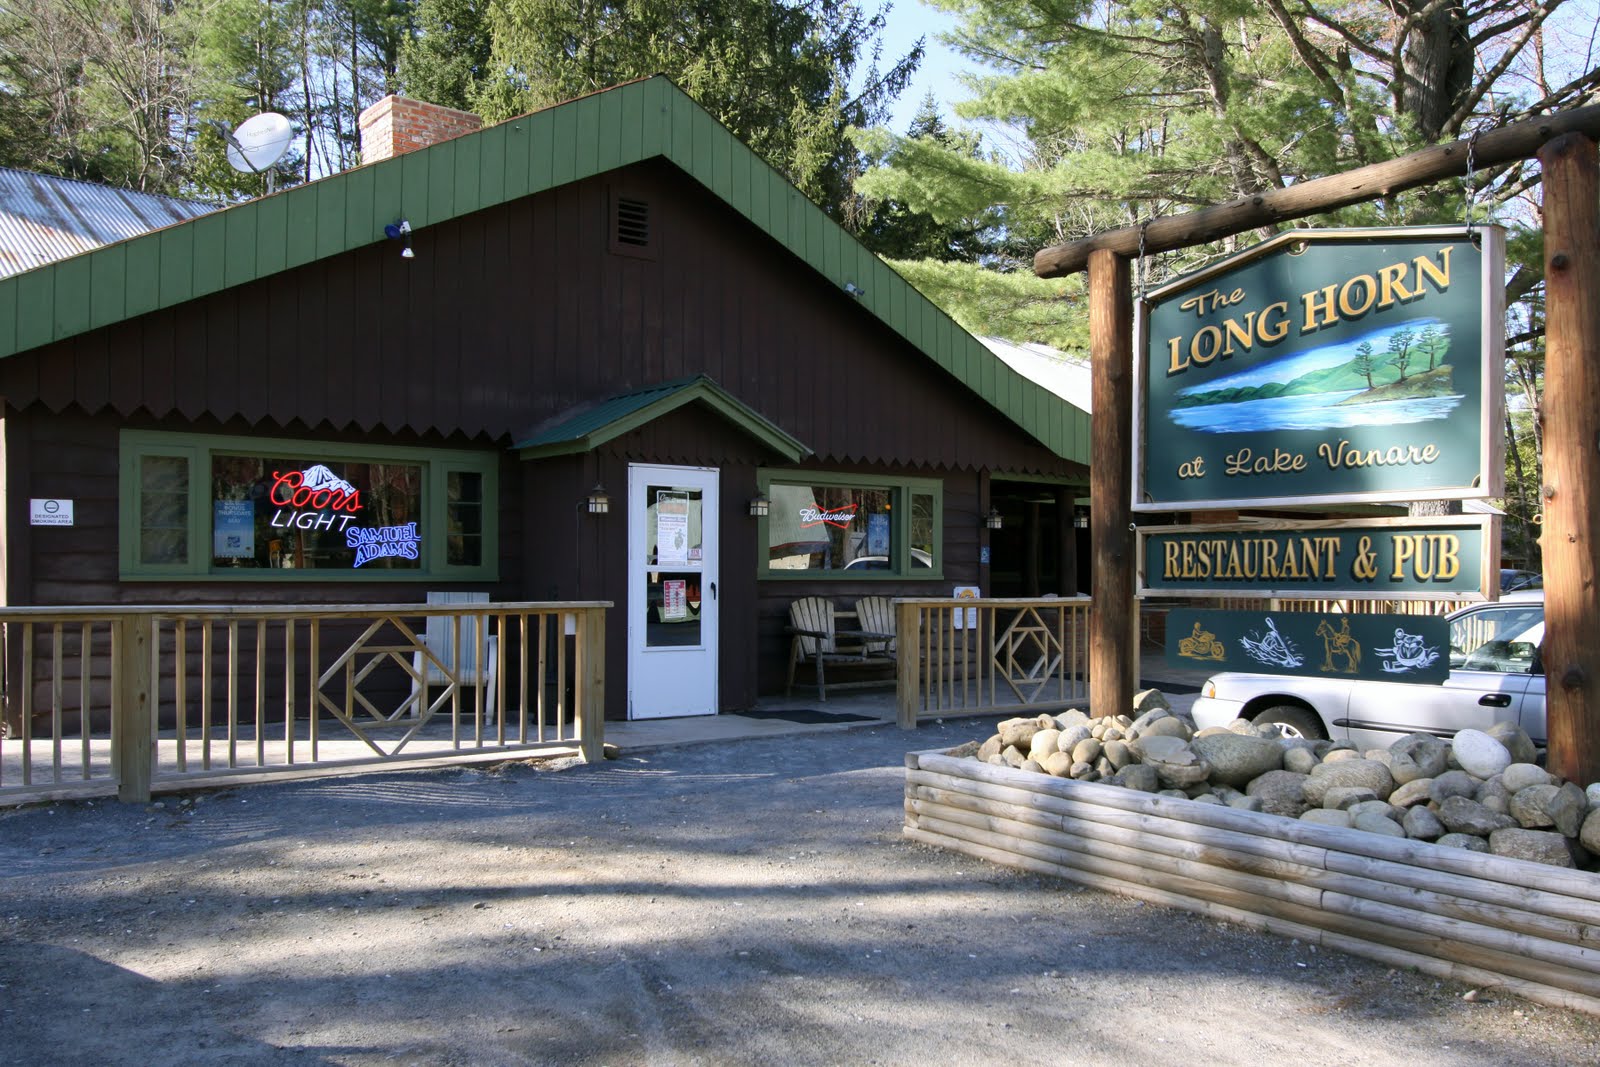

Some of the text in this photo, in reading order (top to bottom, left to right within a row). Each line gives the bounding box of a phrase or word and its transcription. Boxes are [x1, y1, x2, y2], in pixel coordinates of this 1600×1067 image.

[1167, 246, 1454, 374] LONG HORN
[1180, 287, 1246, 316] The
[1178, 440, 1441, 480] at Lake Vanare
[270, 471, 363, 512] Coors
[271, 509, 356, 532] LIGHT
[799, 508, 856, 522] Budweiser
[346, 522, 421, 547] SAMUEL
[353, 541, 418, 568] ADAMS
[1163, 534, 1460, 579] RESTAURANT & PUB
